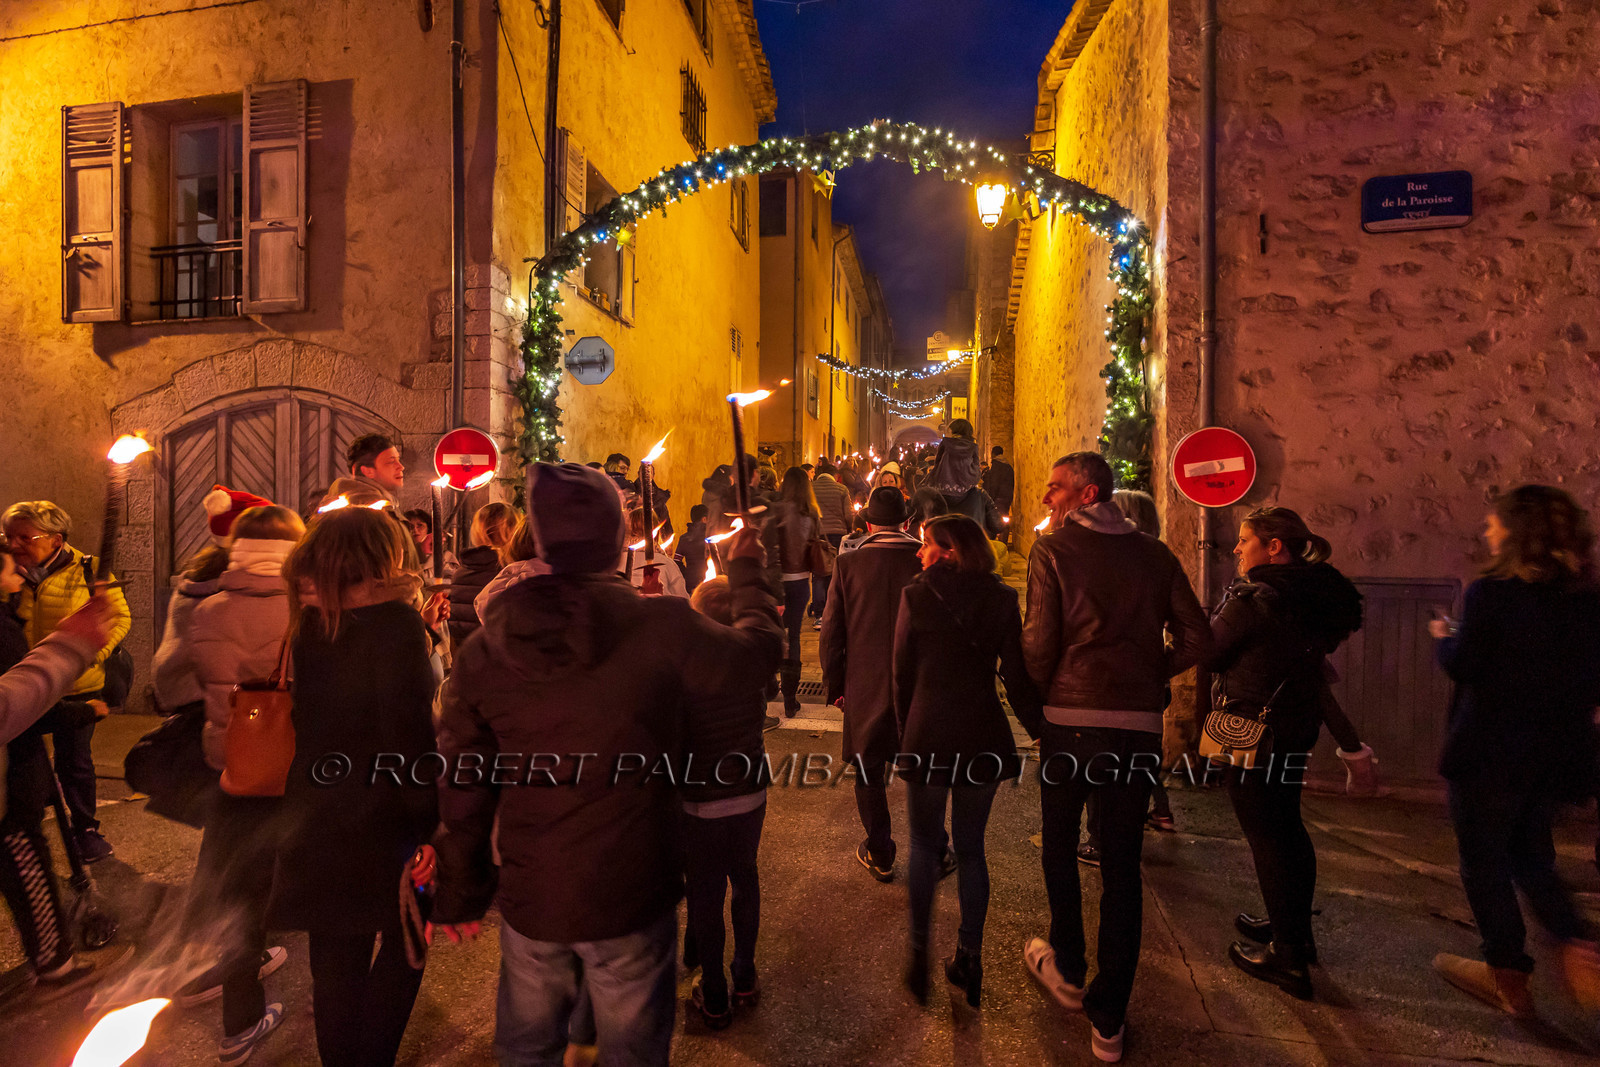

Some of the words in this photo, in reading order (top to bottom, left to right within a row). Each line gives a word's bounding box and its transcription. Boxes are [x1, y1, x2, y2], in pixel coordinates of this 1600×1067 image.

[1407, 182, 1428, 191] Rue
[1382, 198, 1395, 207] de
[1398, 198, 1407, 206] la
[1410, 195, 1453, 205] Paroisse
